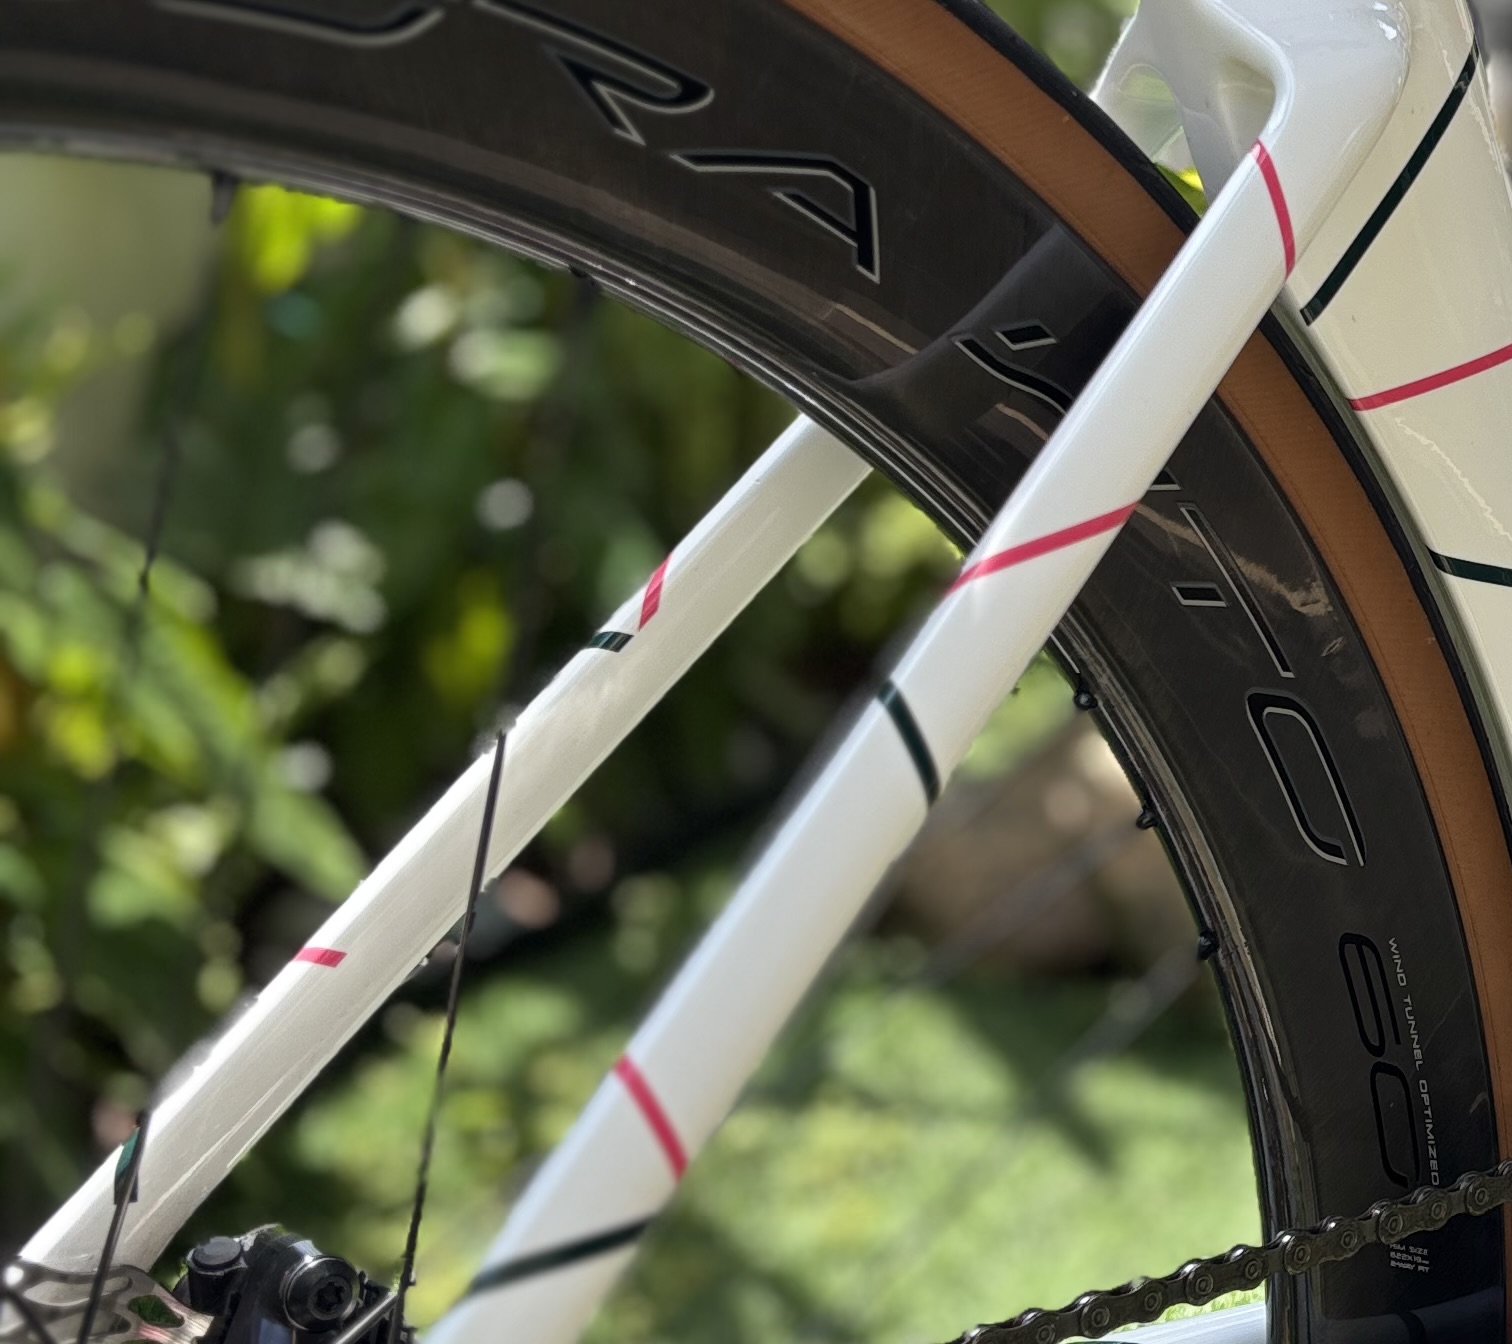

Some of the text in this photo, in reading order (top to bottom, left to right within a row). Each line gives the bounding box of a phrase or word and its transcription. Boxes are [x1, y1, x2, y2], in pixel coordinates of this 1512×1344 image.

[1387, 936, 1440, 1187] WIND TUNNEL OPTIMIZED
